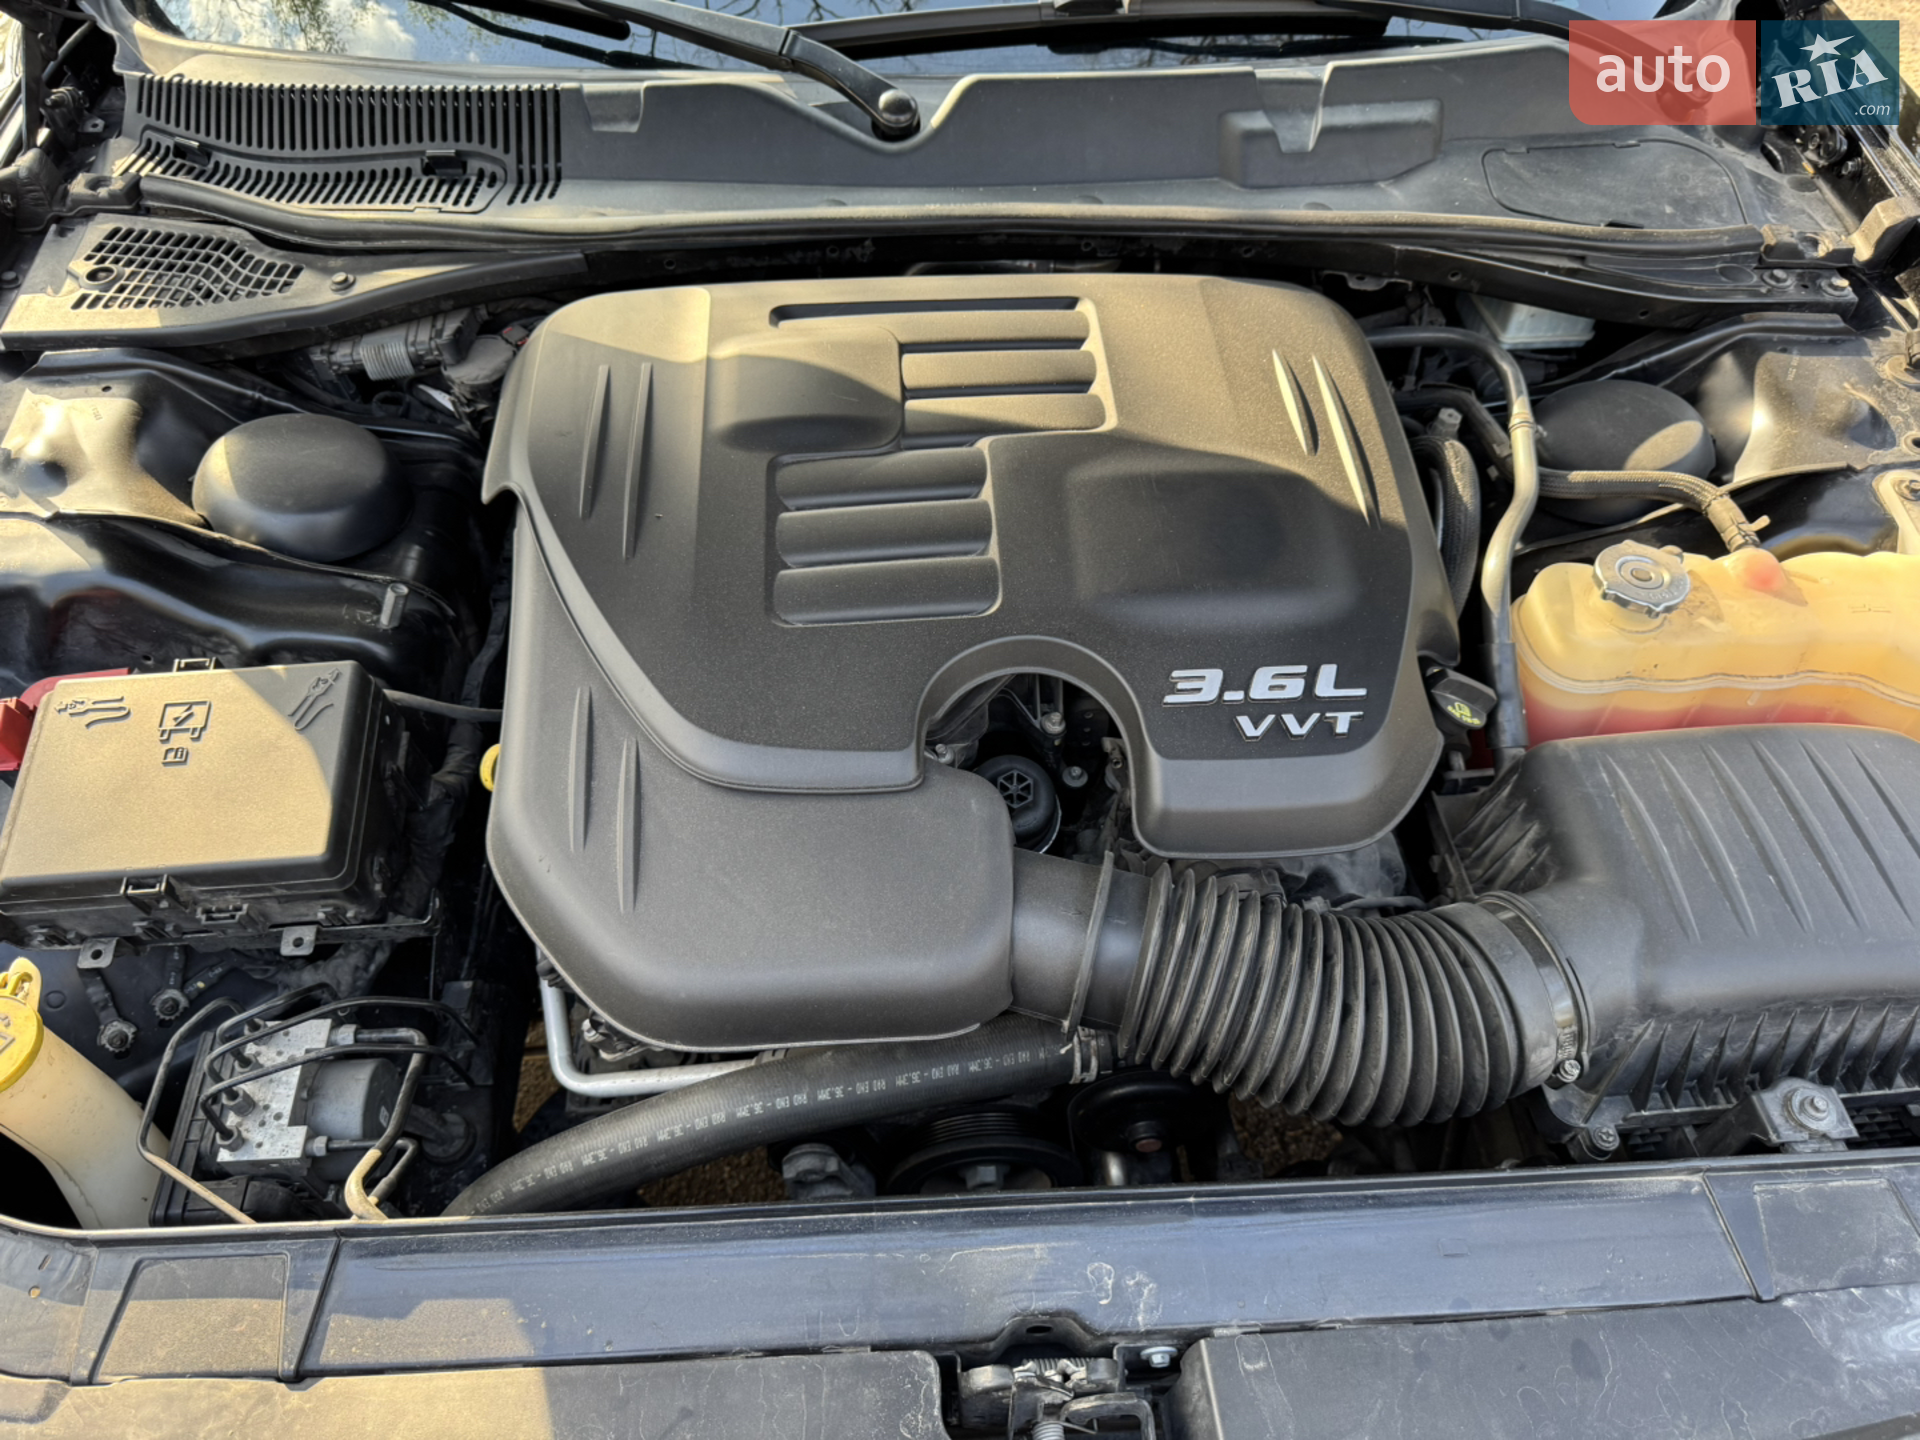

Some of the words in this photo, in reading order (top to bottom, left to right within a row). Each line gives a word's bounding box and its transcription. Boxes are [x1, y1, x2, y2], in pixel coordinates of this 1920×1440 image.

[1163, 663, 1368, 707] 3.6L
[1233, 711, 1364, 742] VVT
[1018, 1051, 1031, 1064] RAD
[947, 1063, 960, 1076] RAD
[873, 1079, 886, 1092] RAD
[793, 1092, 808, 1106] RAD
[711, 1111, 726, 1125] RAD
[634, 1135, 649, 1149] RAD
[559, 1161, 574, 1174] RAD
